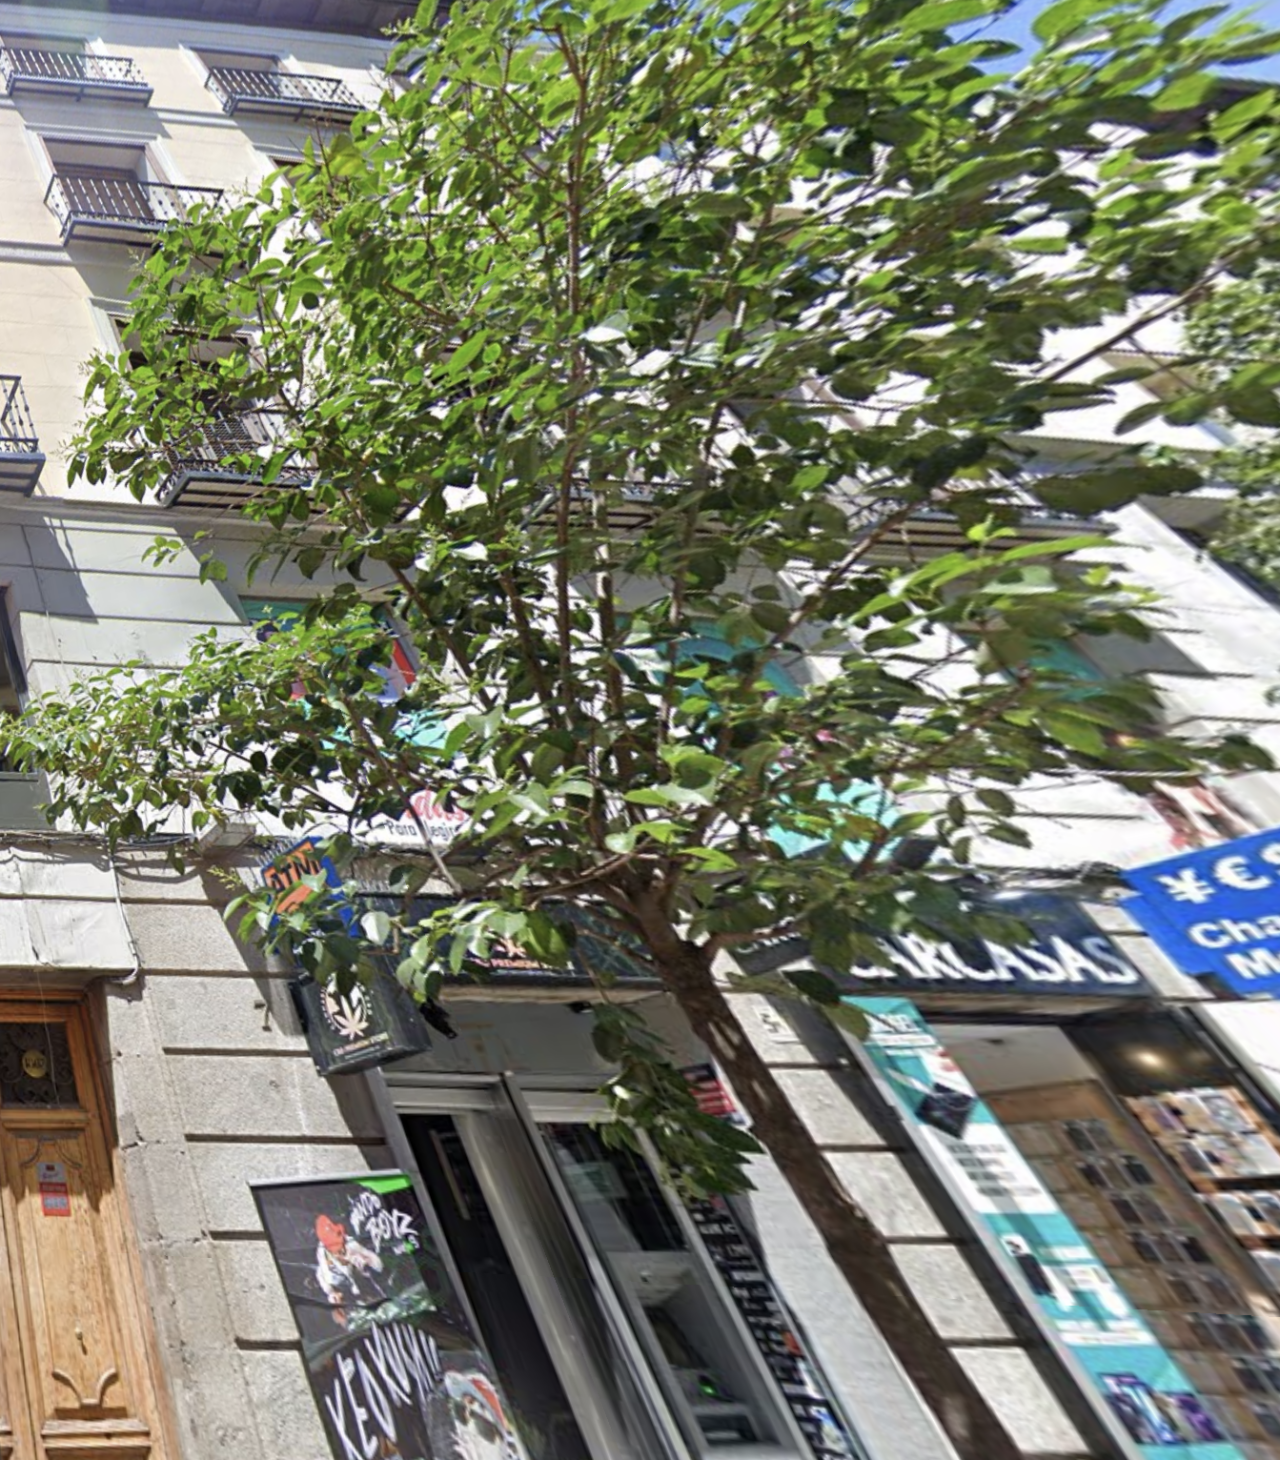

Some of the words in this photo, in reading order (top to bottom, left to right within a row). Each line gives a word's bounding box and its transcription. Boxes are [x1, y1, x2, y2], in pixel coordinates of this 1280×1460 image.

[388, 819, 417, 836] Para
[423, 822, 455, 841] legir
[850, 931, 1139, 983] ARCASAS
[1225, 947, 1280, 979] M
